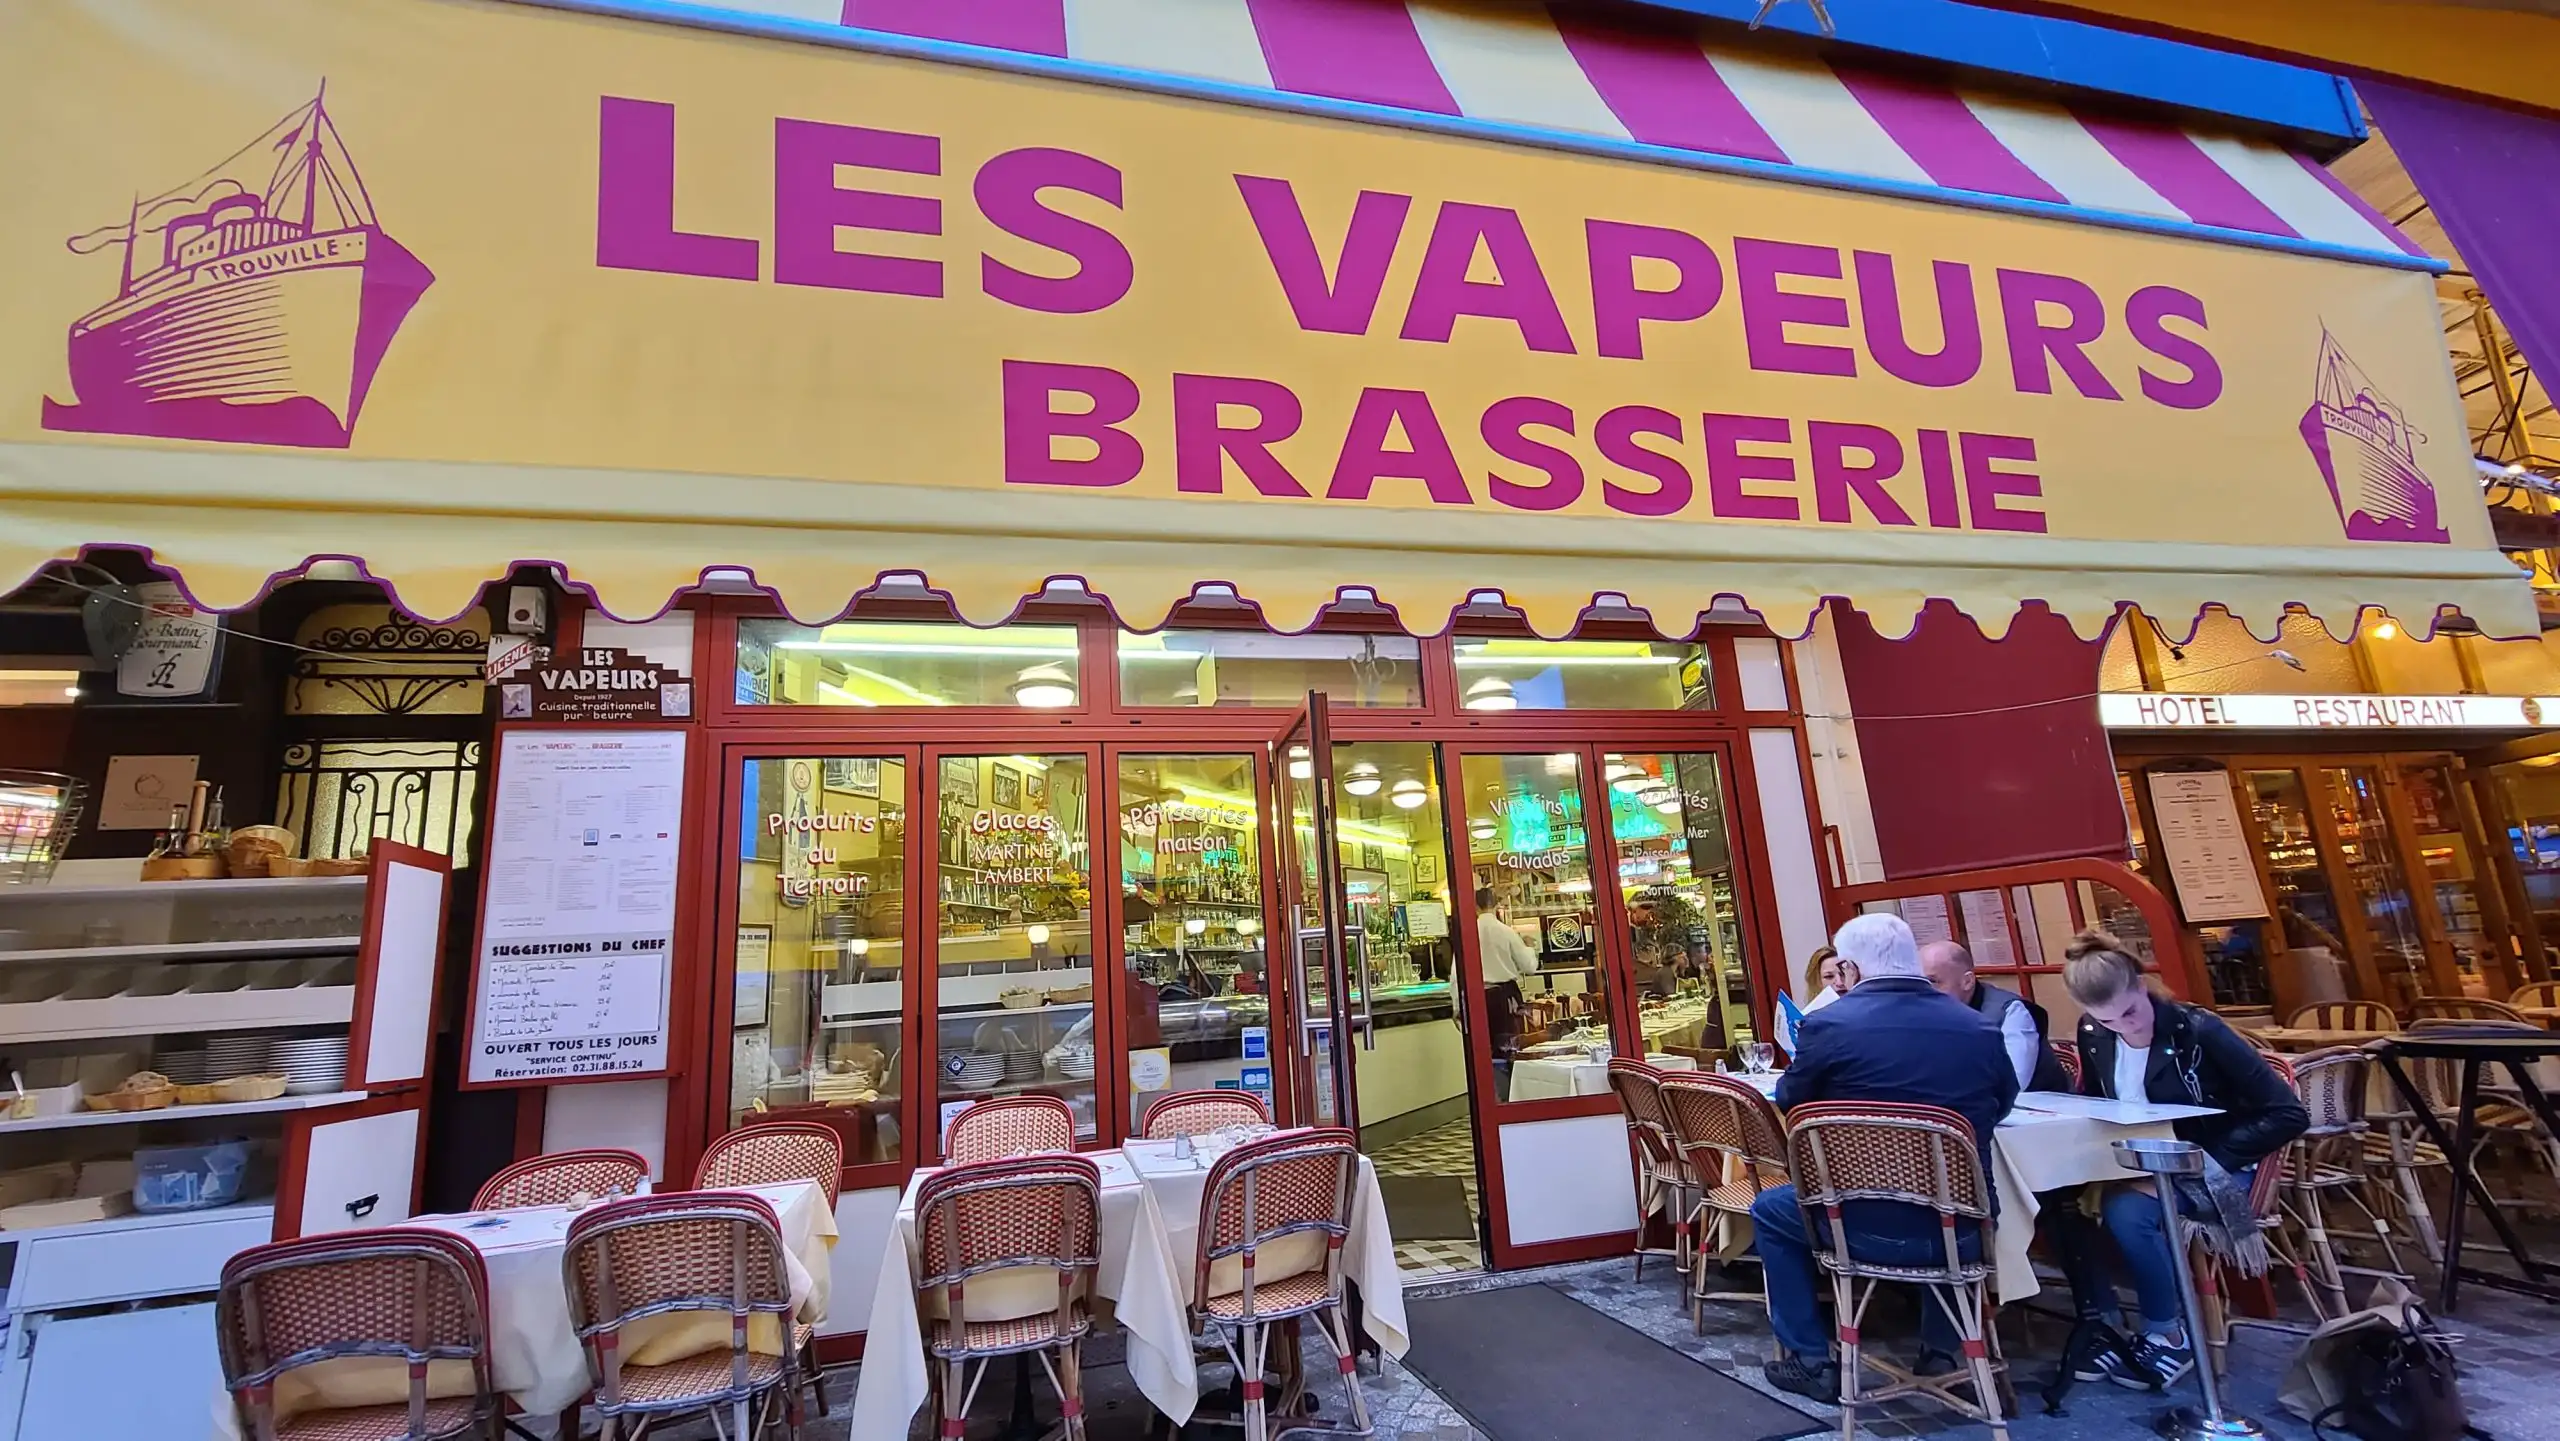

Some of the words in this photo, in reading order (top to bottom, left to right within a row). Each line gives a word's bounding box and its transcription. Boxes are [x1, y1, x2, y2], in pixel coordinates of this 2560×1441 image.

[203, 239, 339, 281] TROUVILLE
[598, 98, 1132, 313] LES
[1237, 176, 2222, 408] VAPEURS
[2324, 411, 2376, 443] TROUVILLE
[1004, 362, 2044, 531] BRASSERIE
[583, 650, 614, 666] LES
[540, 669, 659, 690] VAPEURS
[539, 702, 578, 711] Cuisine
[582, 702, 657, 711] traditionnelle
[563, 712, 582, 722] pur
[593, 711, 633, 720] beurre
[2138, 697, 2237, 724] HOTEL
[2294, 699, 2467, 727] RESTAURANT
[768, 808, 877, 837] Produits
[972, 808, 1054, 833] Glaces
[1130, 802, 1249, 828] Pâtisseries
[1687, 826, 1710, 839] Mer
[807, 841, 837, 865] du
[974, 842, 1054, 861] MARTINE
[1158, 832, 1228, 854] maison
[1497, 850, 1571, 869] Calvados
[776, 872, 868, 896] Terroir
[974, 867, 1054, 885] LAMBERT
[492, 942, 591, 956] SUGGESTIONS
[602, 941, 622, 951] DU
[632, 939, 666, 950] CHEF
[485, 1042, 541, 1055] OUVERT
[550, 1039, 583, 1052] TOUS
[589, 1038, 611, 1049] LES
[617, 1035, 658, 1048] JOURS
[526, 1055, 566, 1065] "SERVICE
[570, 1052, 616, 1063] CONTINU"
[495, 1065, 567, 1078] Réservation:
[572, 1060, 643, 1072] 02.31.88.15.24
[1243, 1073, 1268, 1085] CB
